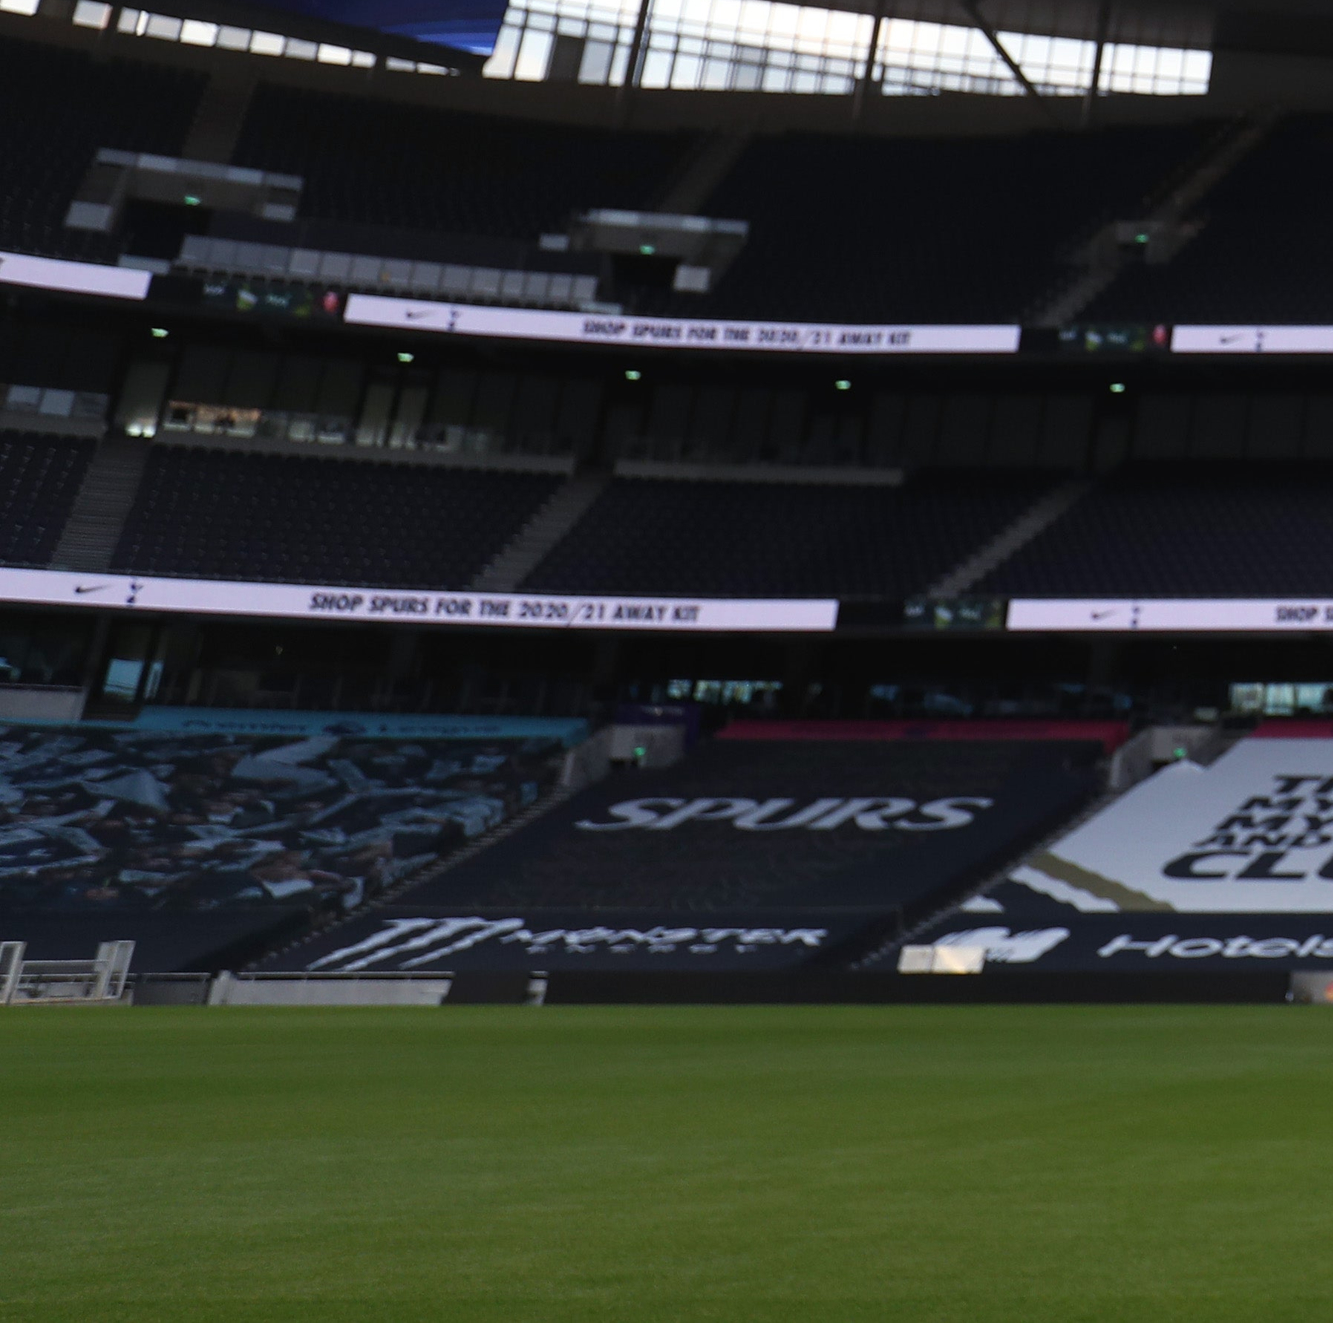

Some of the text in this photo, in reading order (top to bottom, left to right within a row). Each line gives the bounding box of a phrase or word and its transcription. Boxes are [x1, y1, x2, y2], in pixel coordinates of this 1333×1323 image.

[310, 593, 702, 627] SHOP SPURS FOR THE 2020/21 AWAY KIT
[1275, 605, 1318, 622] SHOP
[575, 797, 994, 831] SPURS
[1193, 832, 1333, 850] AND
